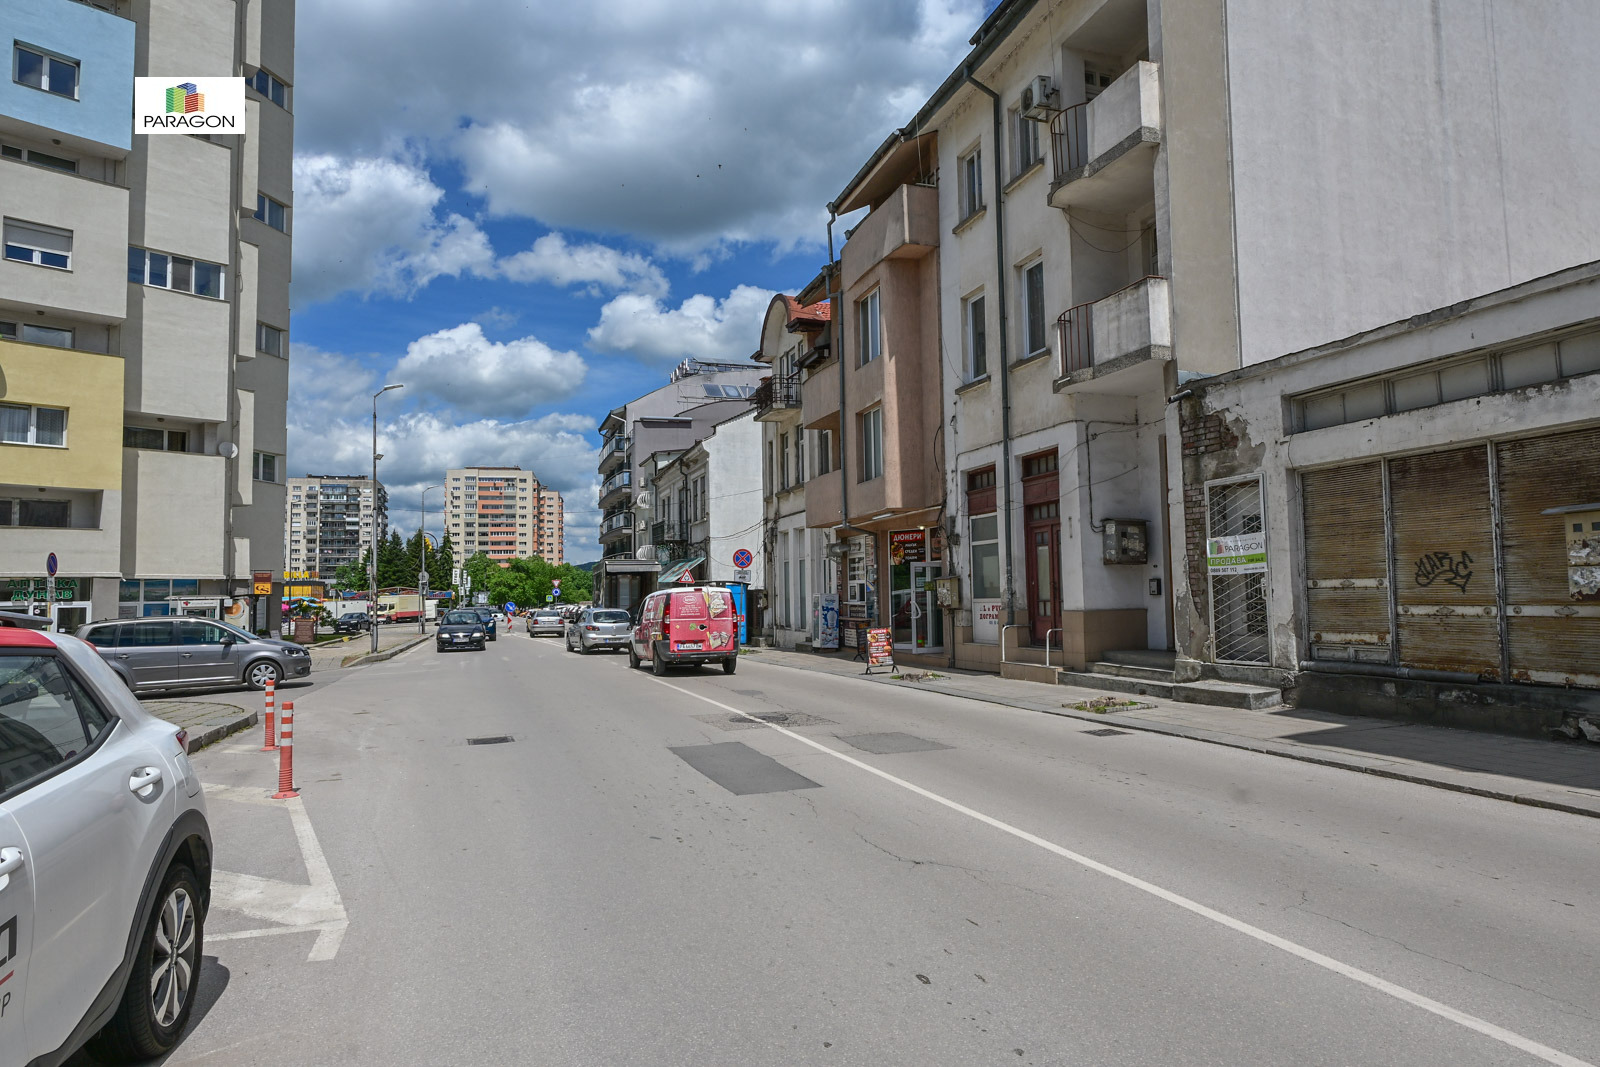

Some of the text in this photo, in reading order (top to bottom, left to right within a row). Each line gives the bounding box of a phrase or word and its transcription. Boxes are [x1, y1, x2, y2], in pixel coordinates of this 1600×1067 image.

[1224, 542, 1263, 552] PARAGON
[1210, 556, 1247, 566] ПРОДАВА
[7, 579, 78, 588] АПТКА
